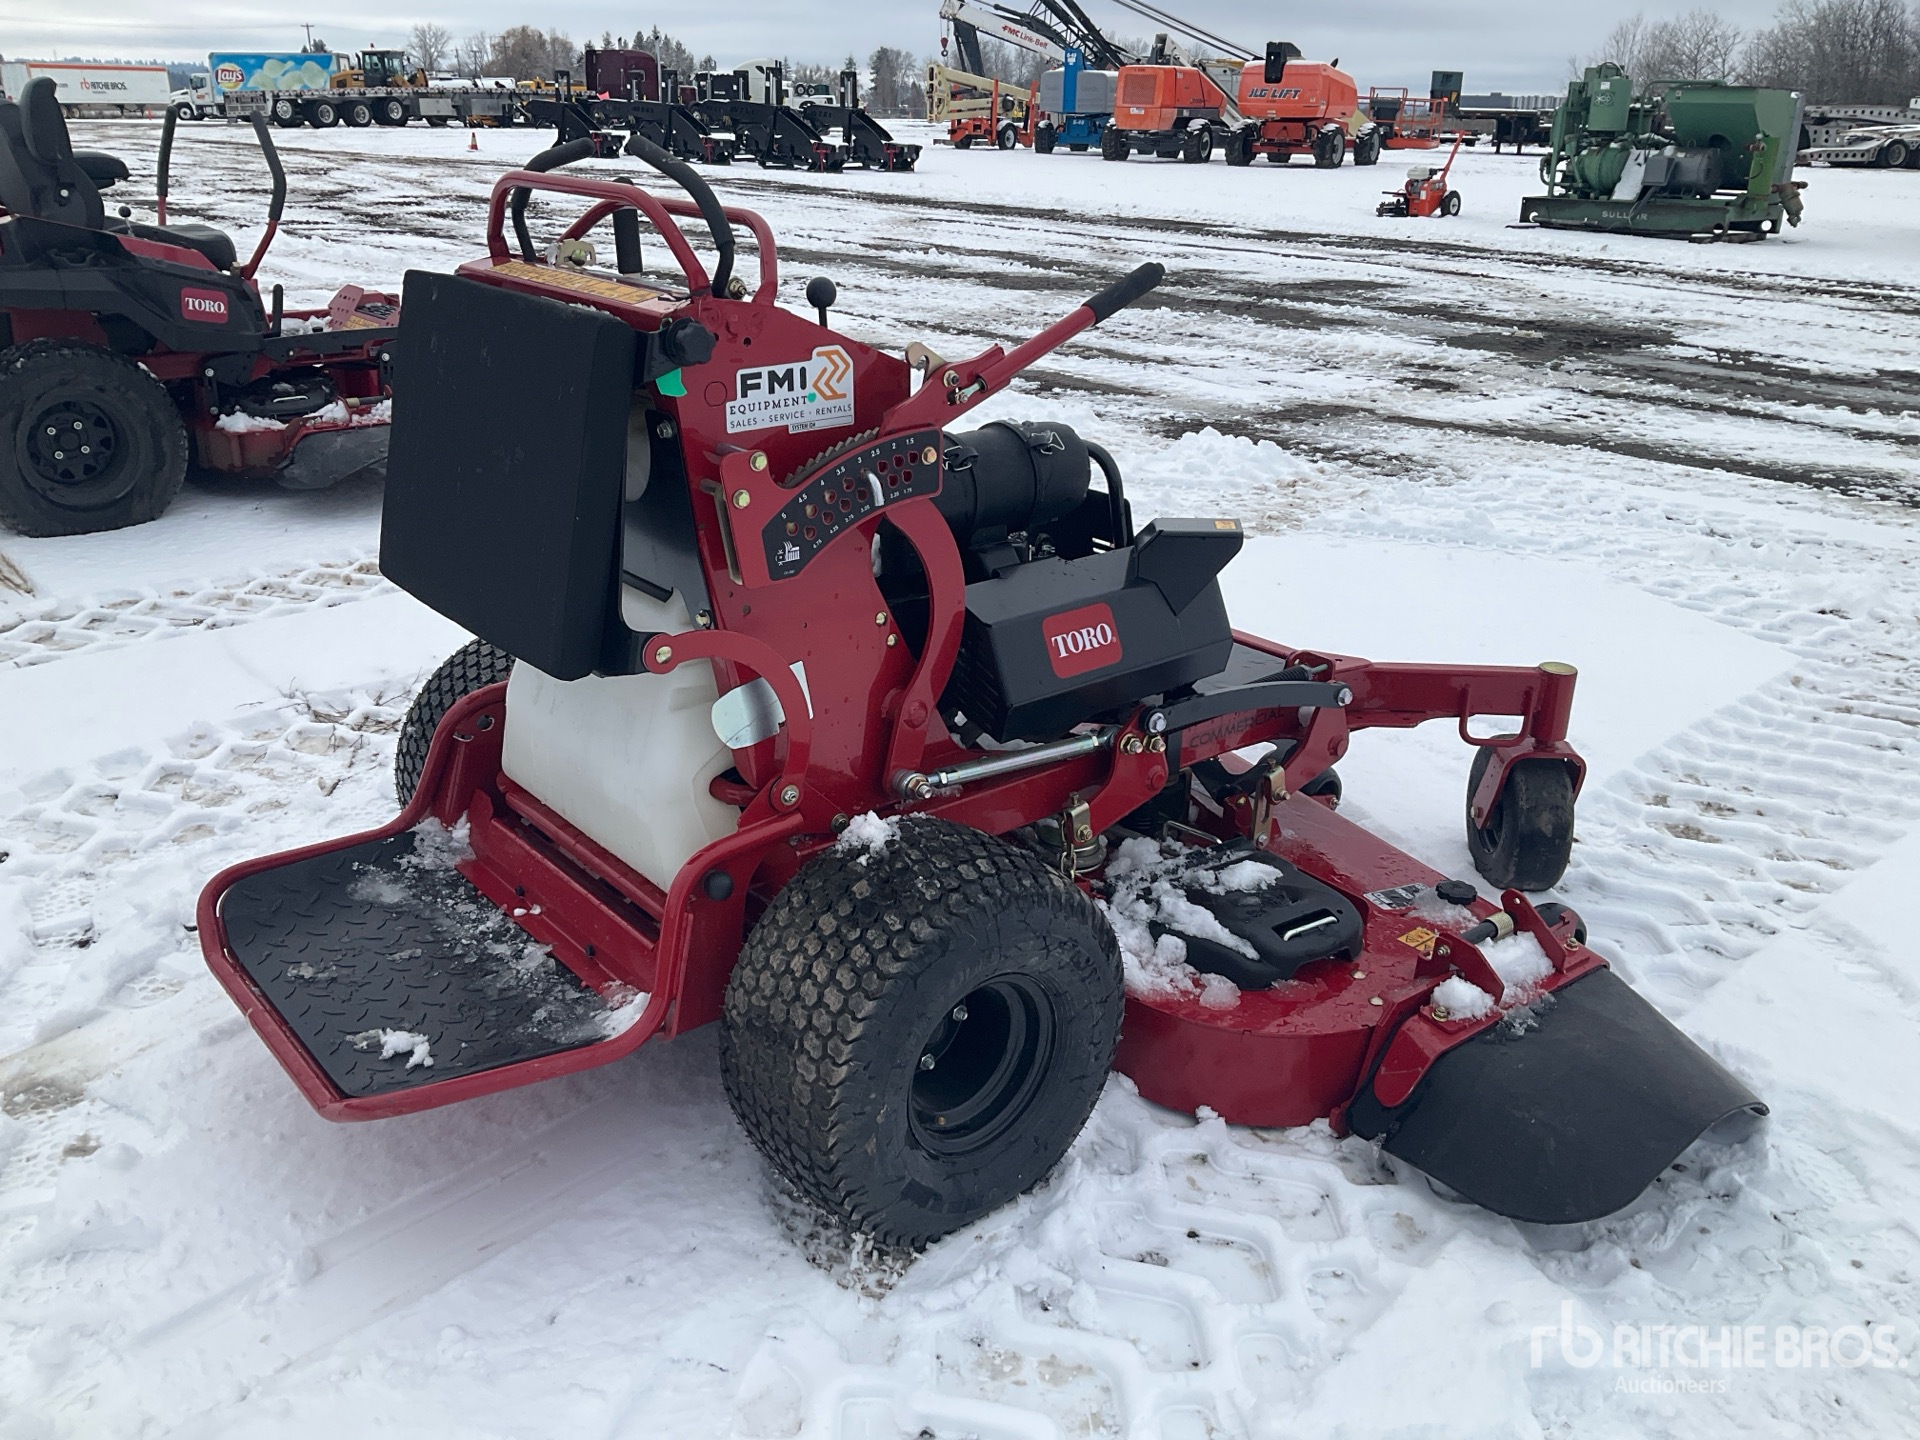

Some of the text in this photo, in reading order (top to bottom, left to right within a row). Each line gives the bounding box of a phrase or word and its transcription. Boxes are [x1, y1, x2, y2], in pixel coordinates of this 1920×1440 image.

[1002, 25, 1020, 37] FMC
[91, 82, 110, 90] RITCHIE
[1248, 88, 1302, 100] JLG LIFT
[1601, 210, 1648, 220] SULLIR
[185, 297, 225, 313] TORO
[740, 366, 807, 398] FMI
[729, 395, 808, 415] EQUIPMENT
[730, 404, 852, 429] SALES SERVICE RENTALS
[791, 423, 808, 431] SYSTEM
[836, 466, 846, 476] 3.5
[857, 456, 862, 464] 3
[871, 448, 880, 457] 2.5
[906, 437, 914, 445] 1.5
[1051, 623, 1113, 658] TORO
[1190, 704, 1284, 748] COMMERCIAL
